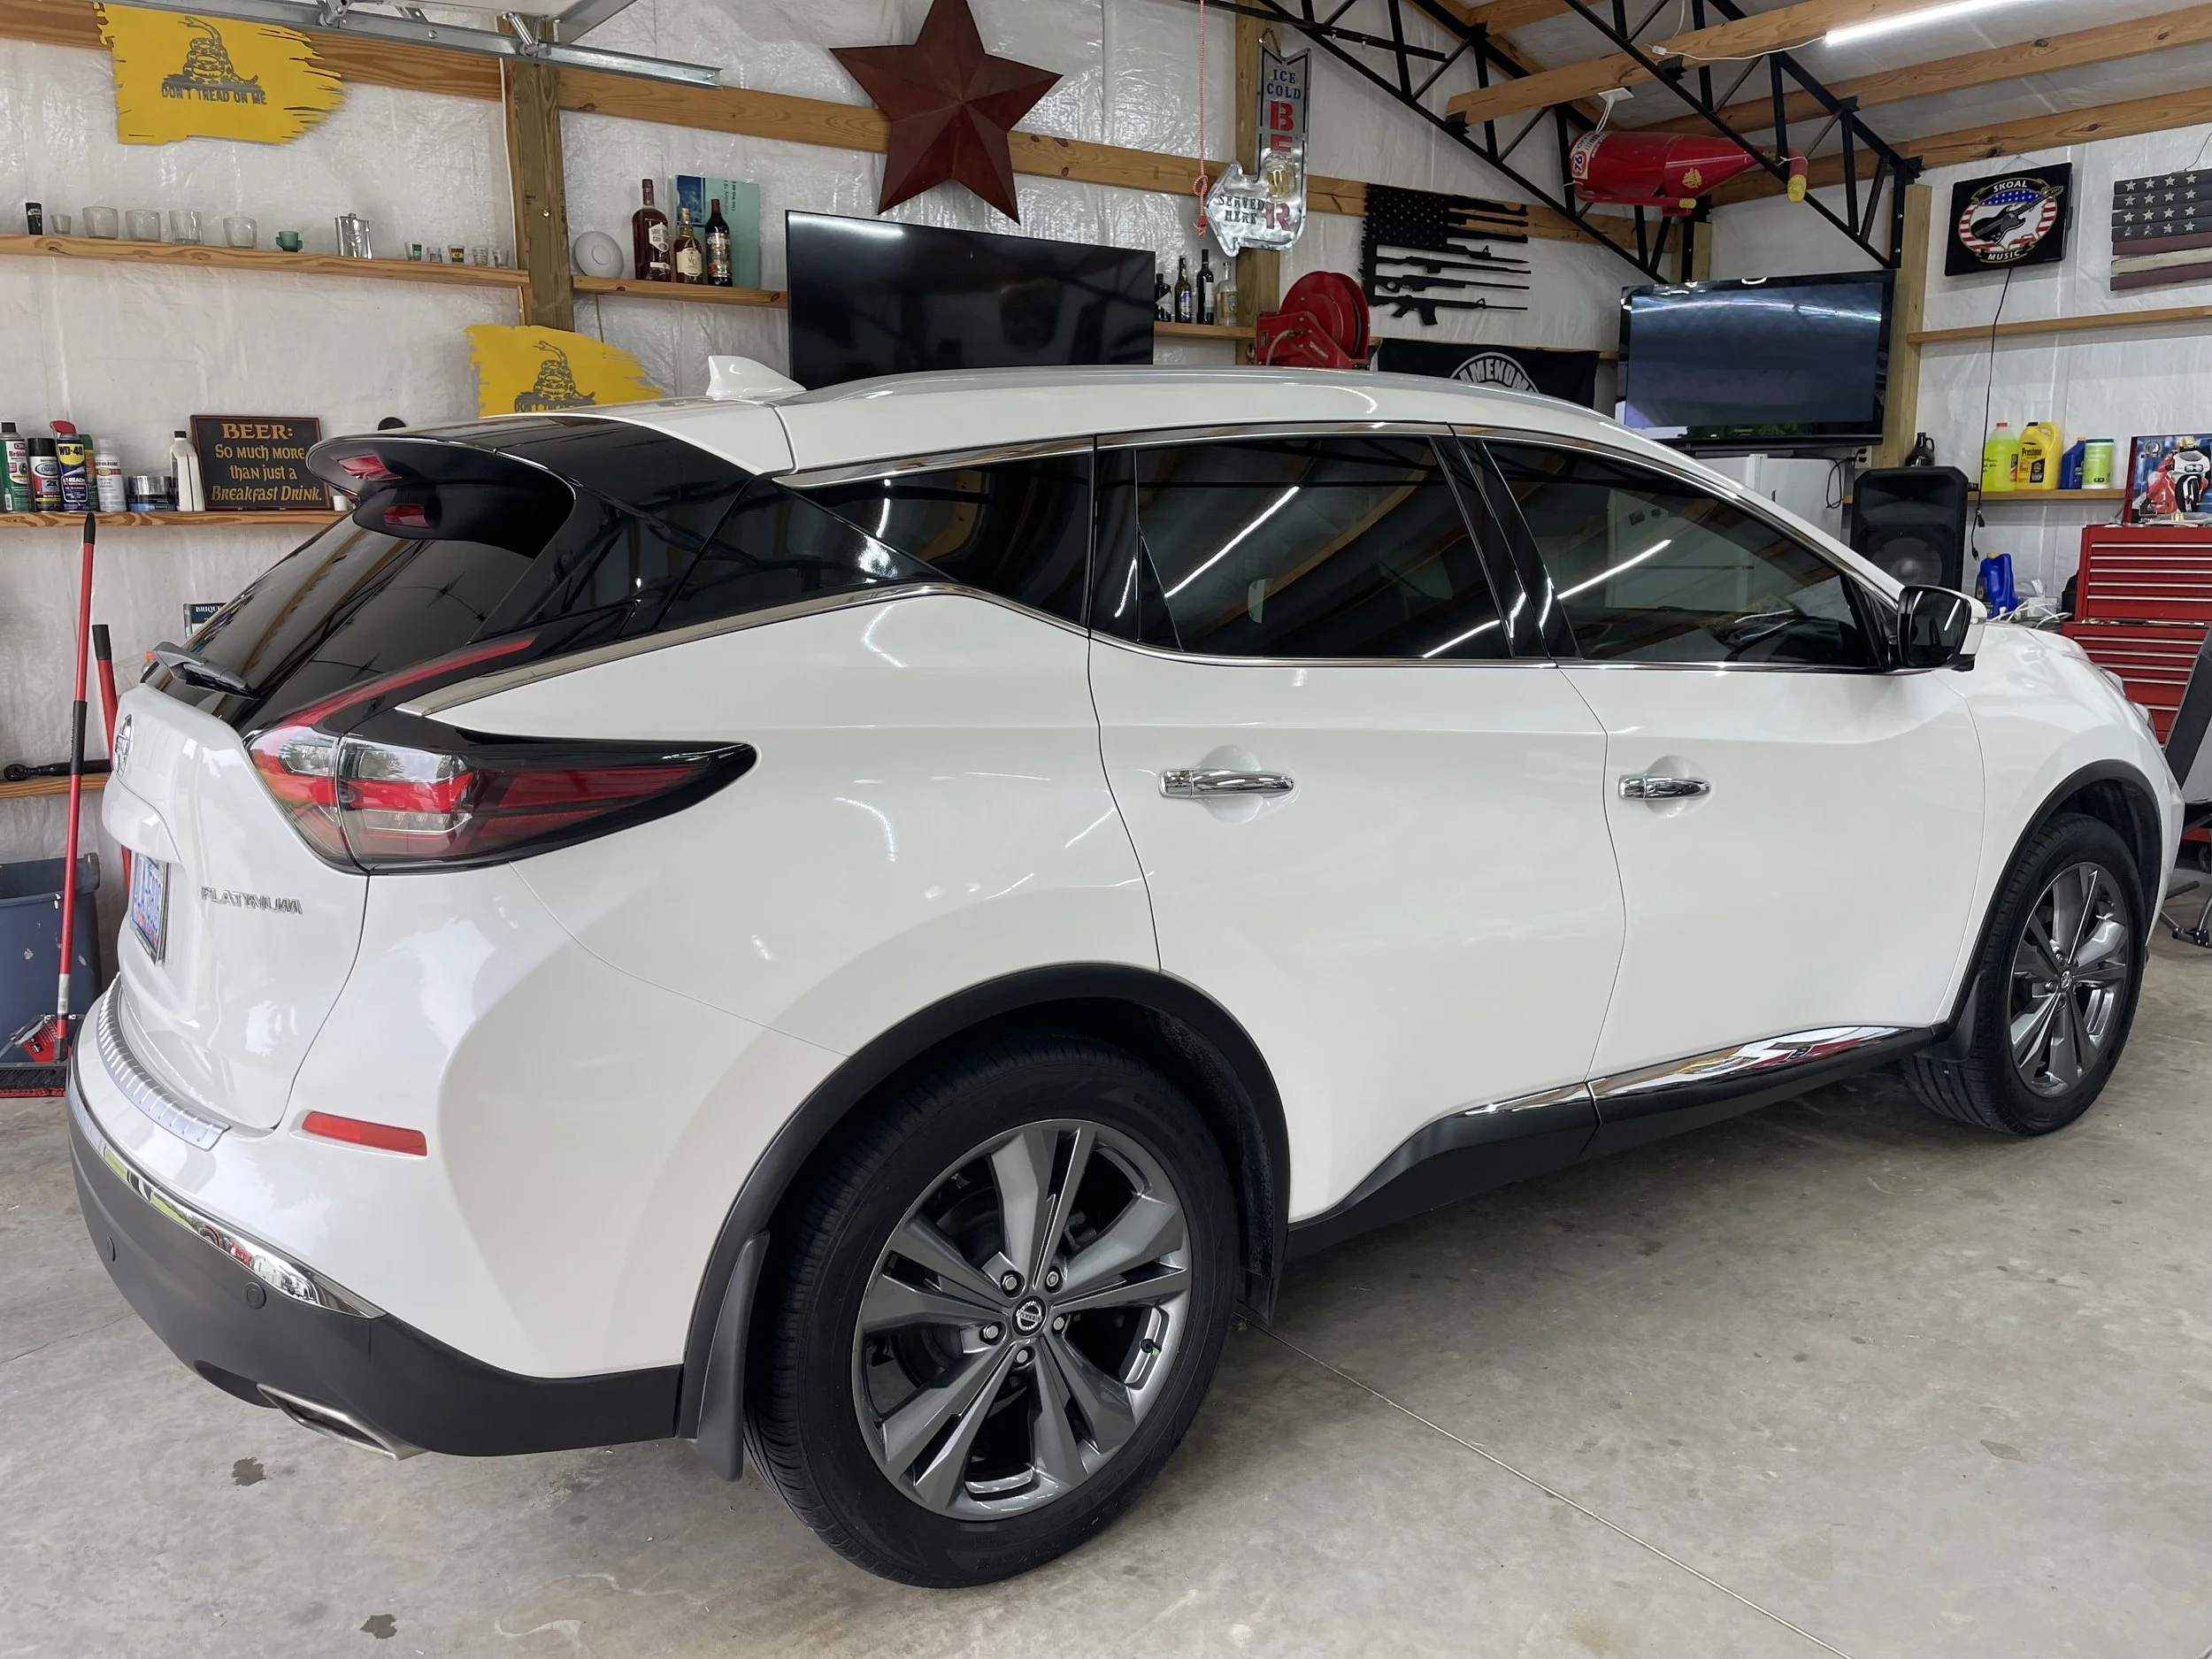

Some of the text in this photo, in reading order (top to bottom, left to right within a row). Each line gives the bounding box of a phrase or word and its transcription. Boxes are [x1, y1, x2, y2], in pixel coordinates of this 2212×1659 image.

[1273, 69, 1296, 84] ICE
[196, 88, 230, 102] TREAD
[234, 90, 249, 104] ON
[251, 91, 268, 105] ME
[1266, 83, 1302, 100] COLD
[1265, 100, 1294, 232] BER
[1993, 180, 2028, 193] SKOAL
[1217, 193, 1265, 211] SERVED
[1225, 210, 1257, 225] HERE
[1987, 250, 2021, 260] MUSIC
[1458, 358, 1535, 392] AMENDM
[221, 423, 294, 440] BEER:
[58, 446, 83, 456] WD-40
[215, 443, 234, 458] So
[262, 464, 286, 481] just
[288, 468, 297, 480] a
[211, 485, 279, 503] Breakfast
[200, 885, 303, 915] PLATINUM
